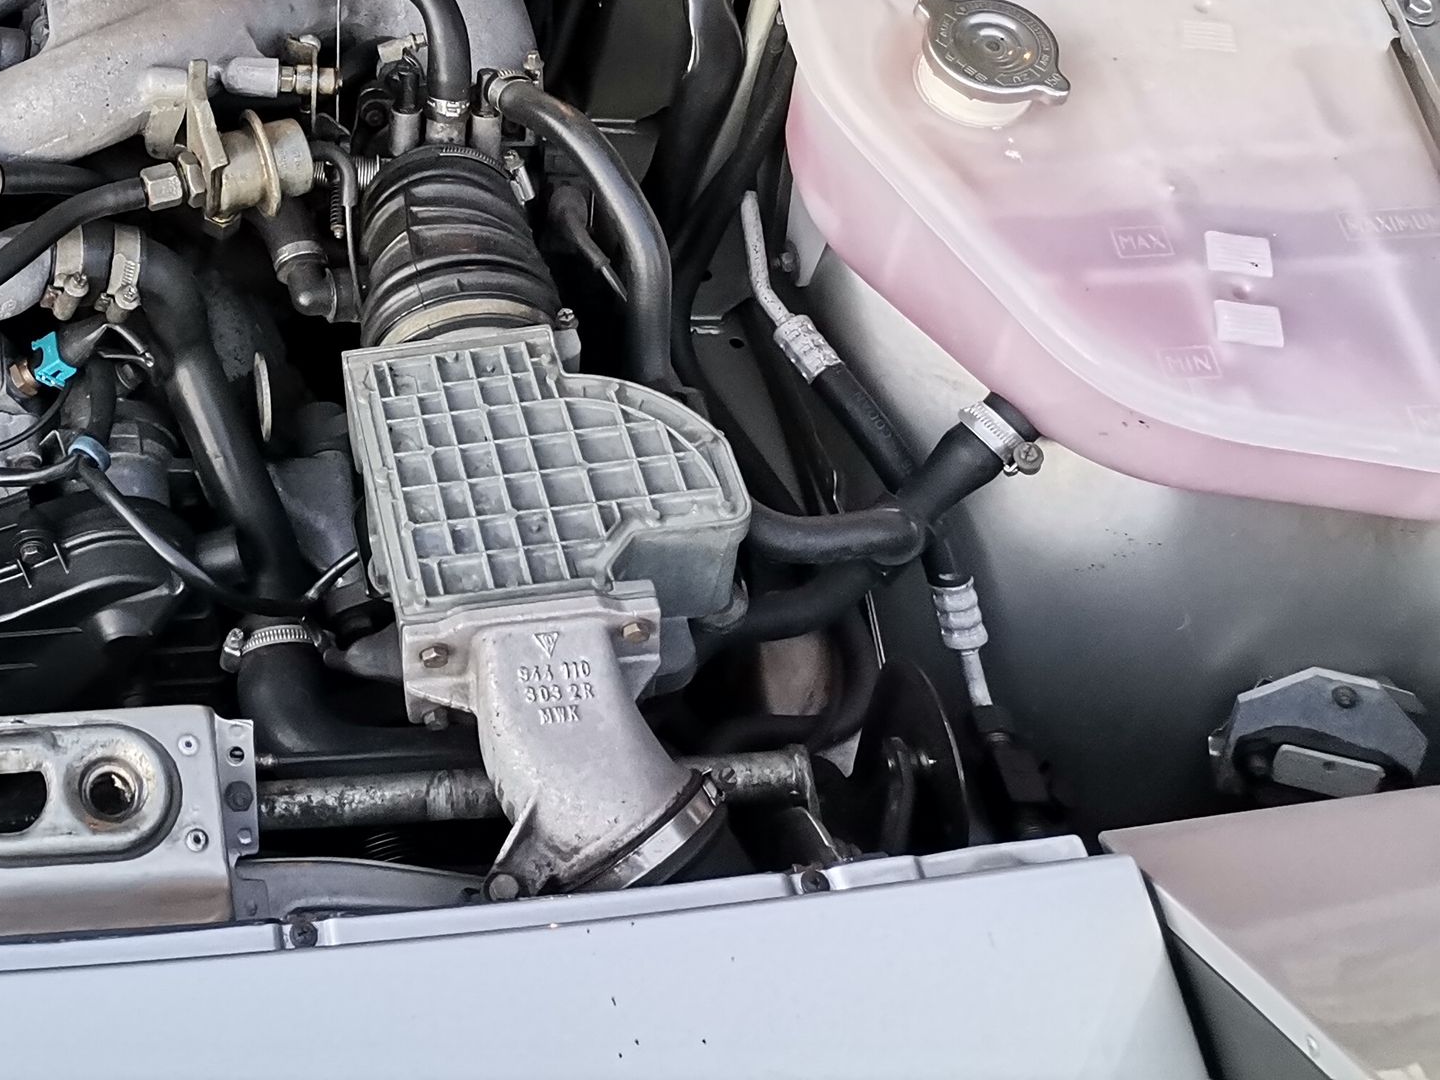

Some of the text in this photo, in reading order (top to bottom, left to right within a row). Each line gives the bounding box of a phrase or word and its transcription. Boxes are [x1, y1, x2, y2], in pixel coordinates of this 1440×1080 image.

[1118, 232, 1166, 250] MAX
[1165, 353, 1212, 372] MIN
[517, 659, 591, 683] 944 110
[566, 681, 595, 702] 2R
[538, 704, 580, 726] MWK
